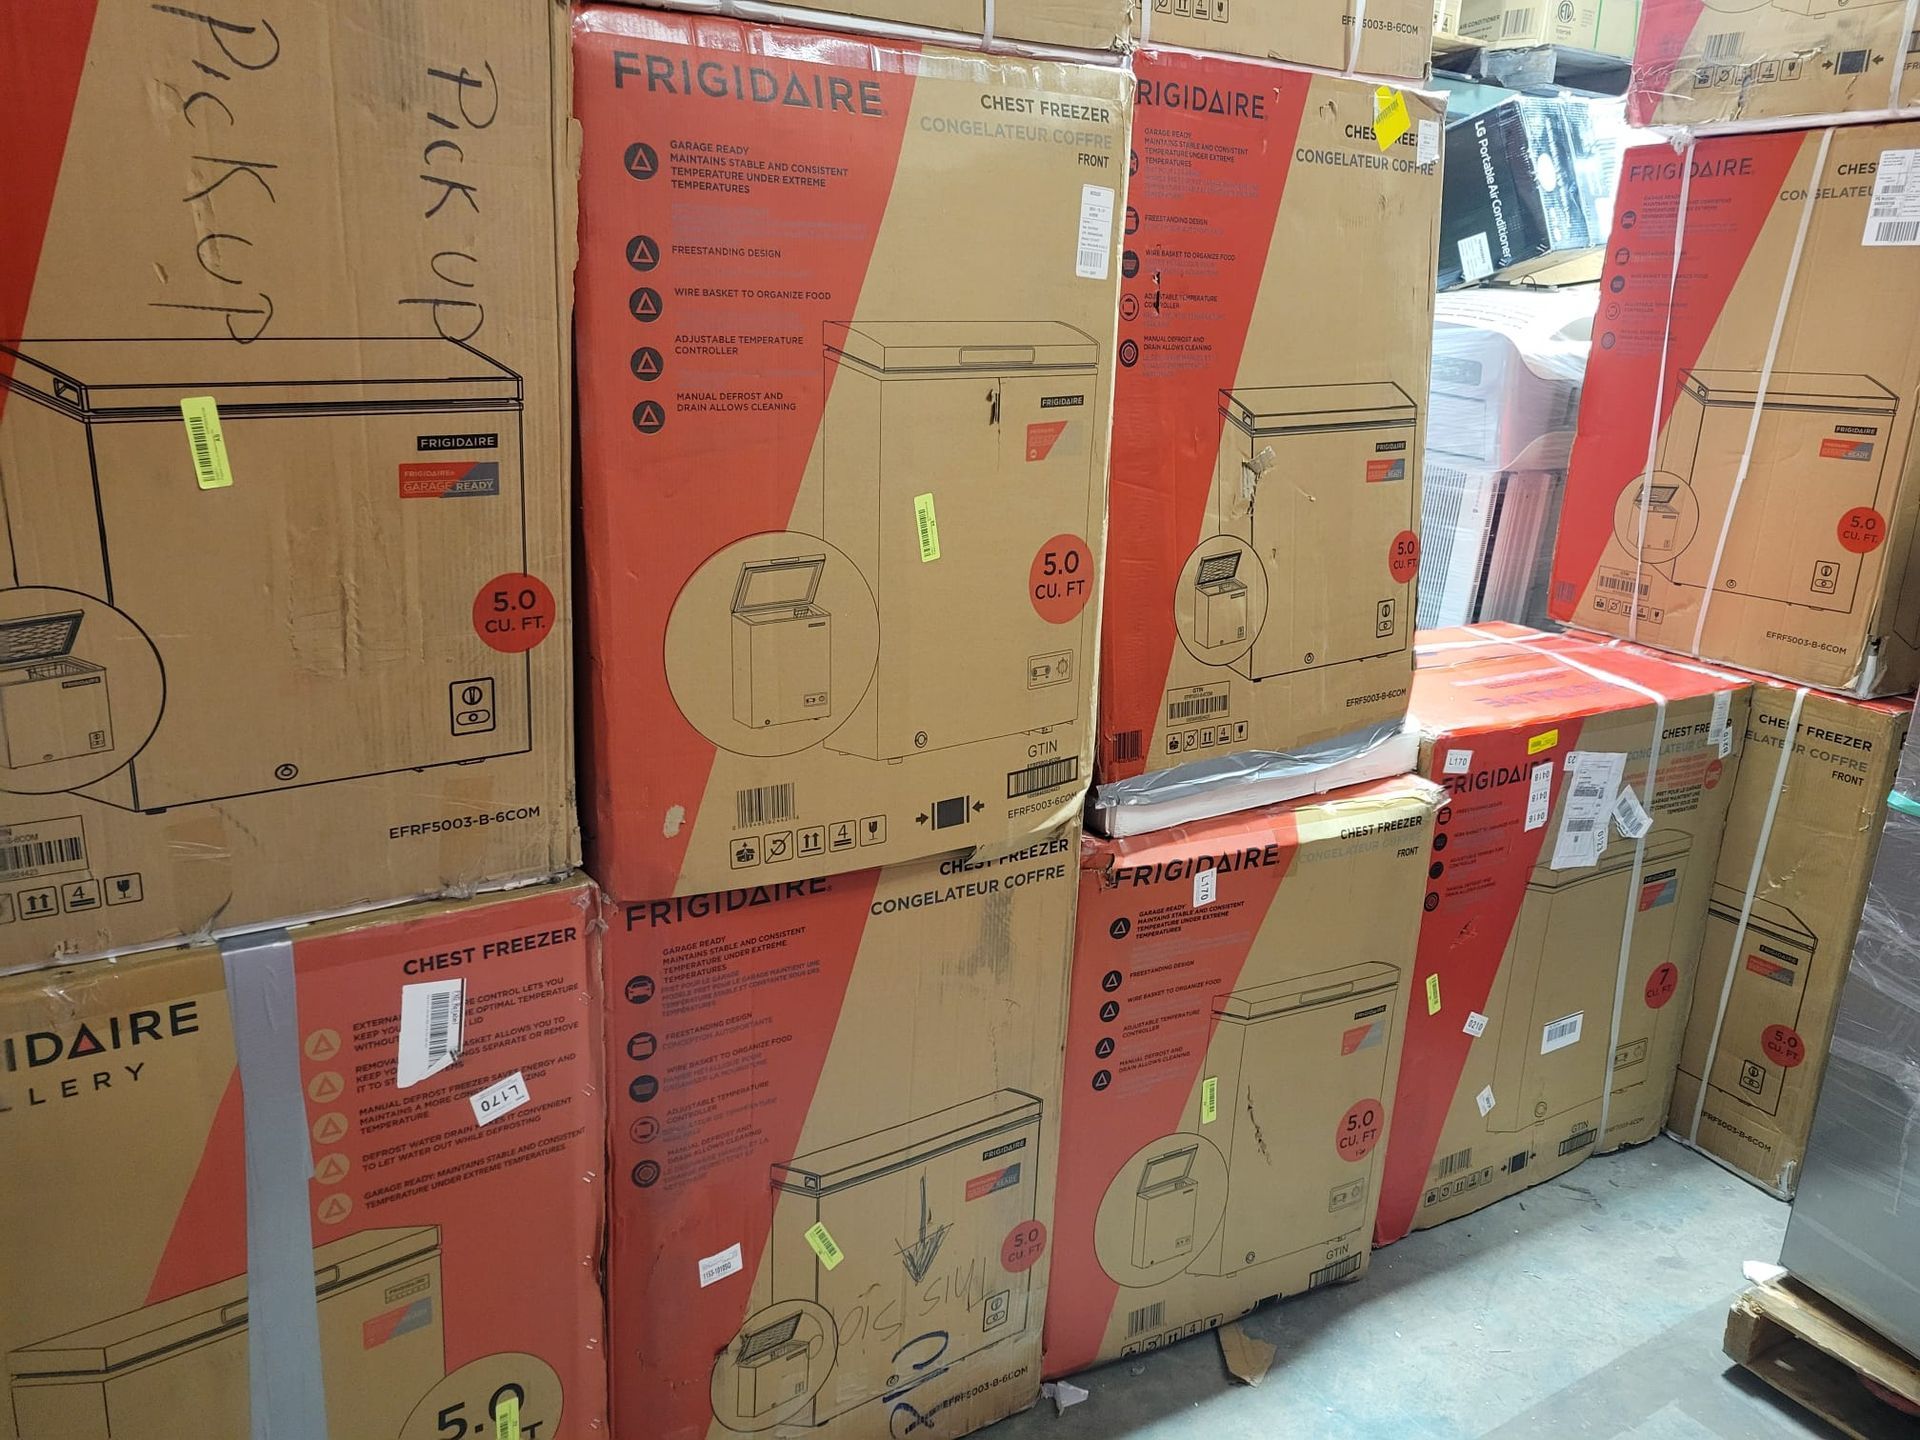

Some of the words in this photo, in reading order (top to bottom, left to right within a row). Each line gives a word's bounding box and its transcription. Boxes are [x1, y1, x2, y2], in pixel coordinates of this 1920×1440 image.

[613, 50, 883, 116] FRIGIDAIRE
[152, 5, 280, 203] PICK
[981, 94, 1035, 115] CHEST
[1040, 101, 1110, 124] FREEZER
[1135, 79, 1265, 120] RIGIDAIRE
[920, 116, 1048, 143] CONGELATEUR
[1053, 130, 1112, 149] COFFRE
[1345, 124, 1377, 141] CHES
[1475, 120, 1486, 137] LG
[420, 61, 499, 218] PICK
[670, 140, 713, 153] GARAGE
[716, 143, 749, 155] READY
[670, 153, 727, 167] MAINTAINS
[729, 158, 765, 171] STABLE
[768, 161, 788, 172] AND
[791, 163, 848, 177] CONSISTENT
[1078, 153, 1110, 169] FRONT
[1295, 148, 1389, 172] CONGELATEUR
[1478, 139, 1495, 184] Portable
[1837, 164, 1877, 176] CHES
[672, 166, 744, 182] TEMPERATURE
[746, 172, 780, 184] UNDER
[782, 174, 826, 188] EXTREME
[672, 179, 750, 194] TEMPERATURES
[1488, 185, 1499, 199] Air
[1492, 199, 1511, 258] Conditioner
[672, 246, 745, 257] FREESTANDING
[747, 248, 781, 258] DESIGN
[149, 234, 273, 344] UP
[398, 252, 484, 342] UP
[675, 288, 700, 297] WIRE
[703, 289, 739, 298] BASKET
[742, 290, 754, 298] TO
[758, 290, 803, 299] ORGANIZE
[806, 291, 831, 300] FOOD
[675, 336, 735, 344] ADJUSTABLE
[739, 336, 804, 344] TEMPERATURE
[675, 347, 738, 355] CONTROLLER
[720, 392, 761, 400] DEFROST
[764, 392, 783, 400] AND
[1042, 397, 1083, 406] FRIGIDAIRE
[677, 403, 707, 412] DRAIN
[710, 403, 749, 411] ALLOWS
[751, 403, 796, 411] CLEANING
[1836, 426, 1876, 435] FRIGIDAIRE
[421, 437, 495, 448] FRIGIDAIRE
[1376, 442, 1405, 451] FRIGIDAIRE
[404, 482, 452, 492] GARAGE
[456, 480, 494, 491] READY
[1850, 515, 1877, 530] 5.0
[1842, 531, 1861, 542] CU.
[1863, 533, 1879, 543] FT.
[1397, 541, 1415, 555] 5.0
[1043, 550, 1079, 576] 5.0
[1393, 560, 1406, 570] CU.
[1035, 582, 1061, 600] CU.
[1067, 579, 1085, 596] FT
[493, 590, 536, 612] 5.0
[485, 619, 516, 634] CU.
[522, 615, 546, 631] FT.
[1766, 631, 1847, 655] EFRF5003-B-6COM
[1346, 687, 1407, 708] EFRF5003-B-6COM
[1662, 726, 1692, 739] CHEST
[1806, 726, 1872, 752] FREEZER
[1027, 740, 1058, 759] GTIN
[1809, 747, 1868, 773] COFFRE
[1832, 770, 1864, 787] FRONT
[390, 806, 540, 839] EFRF5003-B-6COM
[1341, 823, 1375, 841] CHEST
[1377, 815, 1423, 834] FREEZER
[1397, 846, 1419, 859] FRONT
[870, 876, 1000, 916] CONGELATEUR
[1004, 864, 1066, 890] COFFRE
[1200, 875, 1209, 901] L170
[626, 877, 826, 931] FRIGIDAIRE
[403, 946, 475, 976] CHEST
[482, 926, 577, 960] FREEZER
[663, 948, 708, 965] MAINTAINS
[710, 942, 739, 955] STABLE
[758, 926, 806, 944] CONSISTENT
[663, 941, 697, 956] GARAGE
[699, 935, 726, 948] READY
[663, 955, 722, 975] TEMPERATURE
[1660, 968, 1669, 986] 7
[476, 997, 516, 1014] OPTIMAL
[518, 983, 579, 1004] TEMPERATURE
[477, 987, 520, 1003] CONTROL
[522, 982, 543, 993] LETS
[353, 1029, 379, 1041] KEEP
[482, 1034, 527, 1052] SEPARATE
[544, 1021, 579, 1037] REMOVE
[494, 1024, 531, 1039] ALLOWS
[1774, 1031, 1797, 1048] 5.0
[521, 1058, 555, 1073] ENERGY
[359, 1098, 401, 1115] MANUAL
[404, 1087, 446, 1104] DEFROST
[449, 1076, 489, 1093] FREEZER
[481, 1085, 519, 1112] L170
[360, 1105, 412, 1126] MAINTAINS
[425, 1096, 450, 1109] MORE
[517, 1097, 572, 1118] CONVENIENT
[361, 1111, 430, 1135] TEMPERATURE
[486, 1116, 541, 1136] DEFROSTING
[1346, 1110, 1374, 1131] 5.0
[362, 1143, 407, 1161] DEFROST
[409, 1133, 441, 1148] WATER
[444, 1124, 473, 1139] DRAIN
[455, 1132, 484, 1146] WHILE
[487, 1148, 515, 1163] STABLE
[538, 1127, 585, 1148] CONSISTENT
[984, 1139, 1025, 1160] FRIGIDAIRE
[1339, 1133, 1357, 1150] CU.
[1362, 1129, 1377, 1143] FT
[398, 1146, 431, 1162] WATER
[464, 1162, 502, 1180] EXTREME
[504, 1144, 566, 1168] TEMPERATURES
[437, 1158, 485, 1177] MAINTAINS
[364, 1183, 402, 1200] GARAGE
[366, 1184, 428, 1209] TEMPERATURE
[431, 1175, 461, 1190] UNDER
[1014, 1228, 1038, 1248] 5.0
[1326, 1244, 1349, 1261] GTIN
